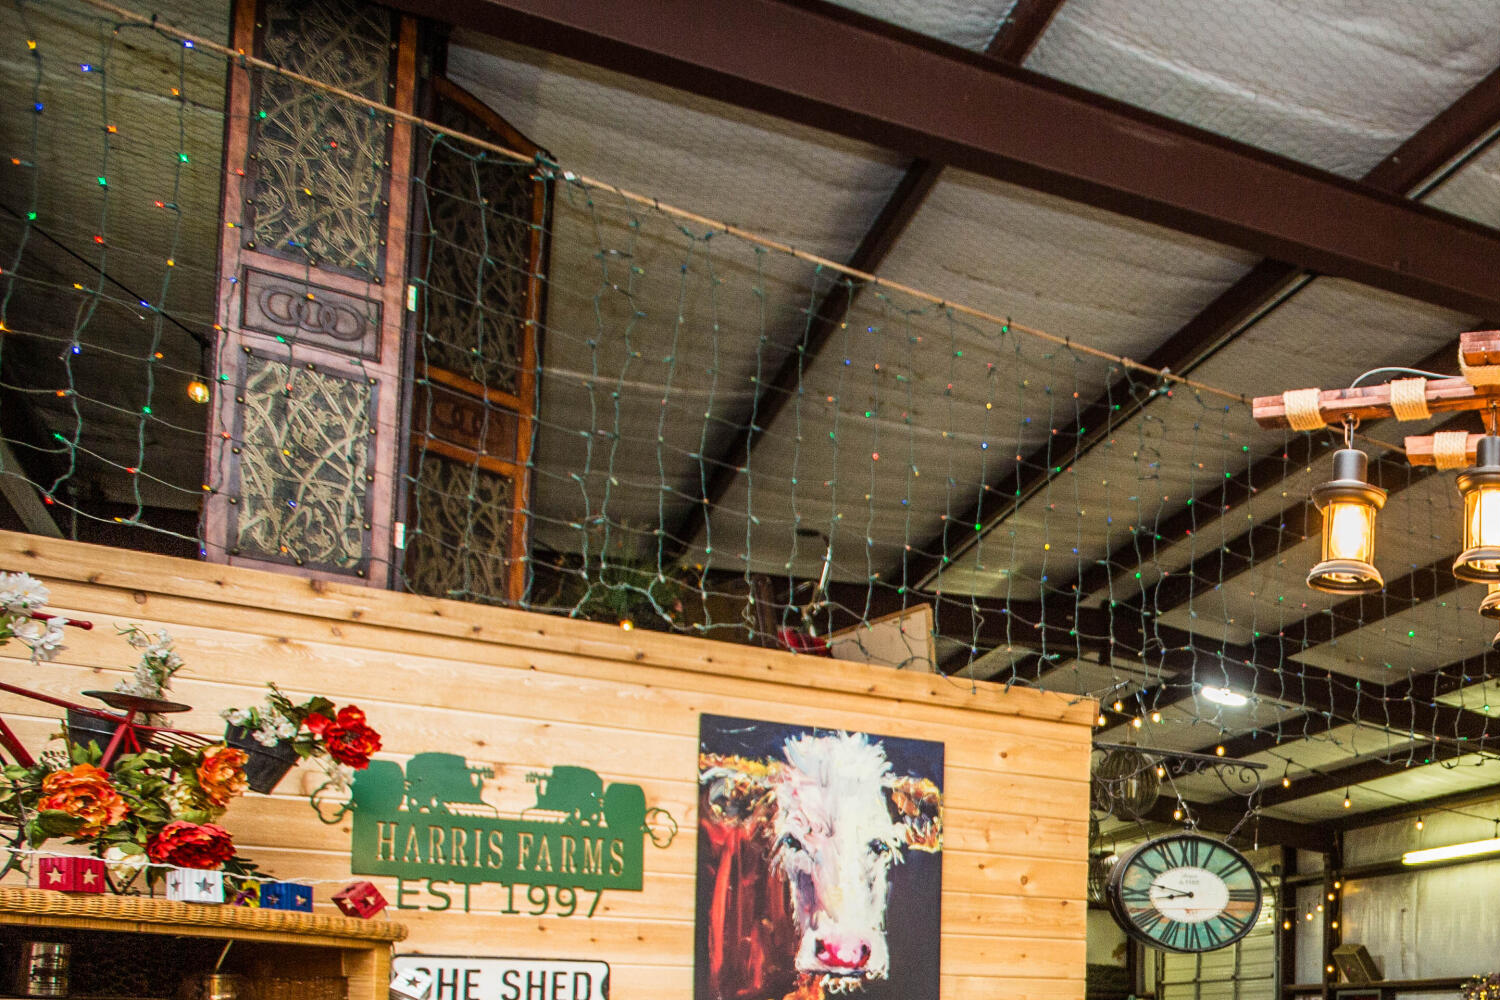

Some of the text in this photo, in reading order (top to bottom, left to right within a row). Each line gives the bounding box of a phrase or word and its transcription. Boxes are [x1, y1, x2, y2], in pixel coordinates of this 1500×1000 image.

[376, 820, 625, 877] HARRIS FARMS
[397, 877, 603, 918] EST 1997
